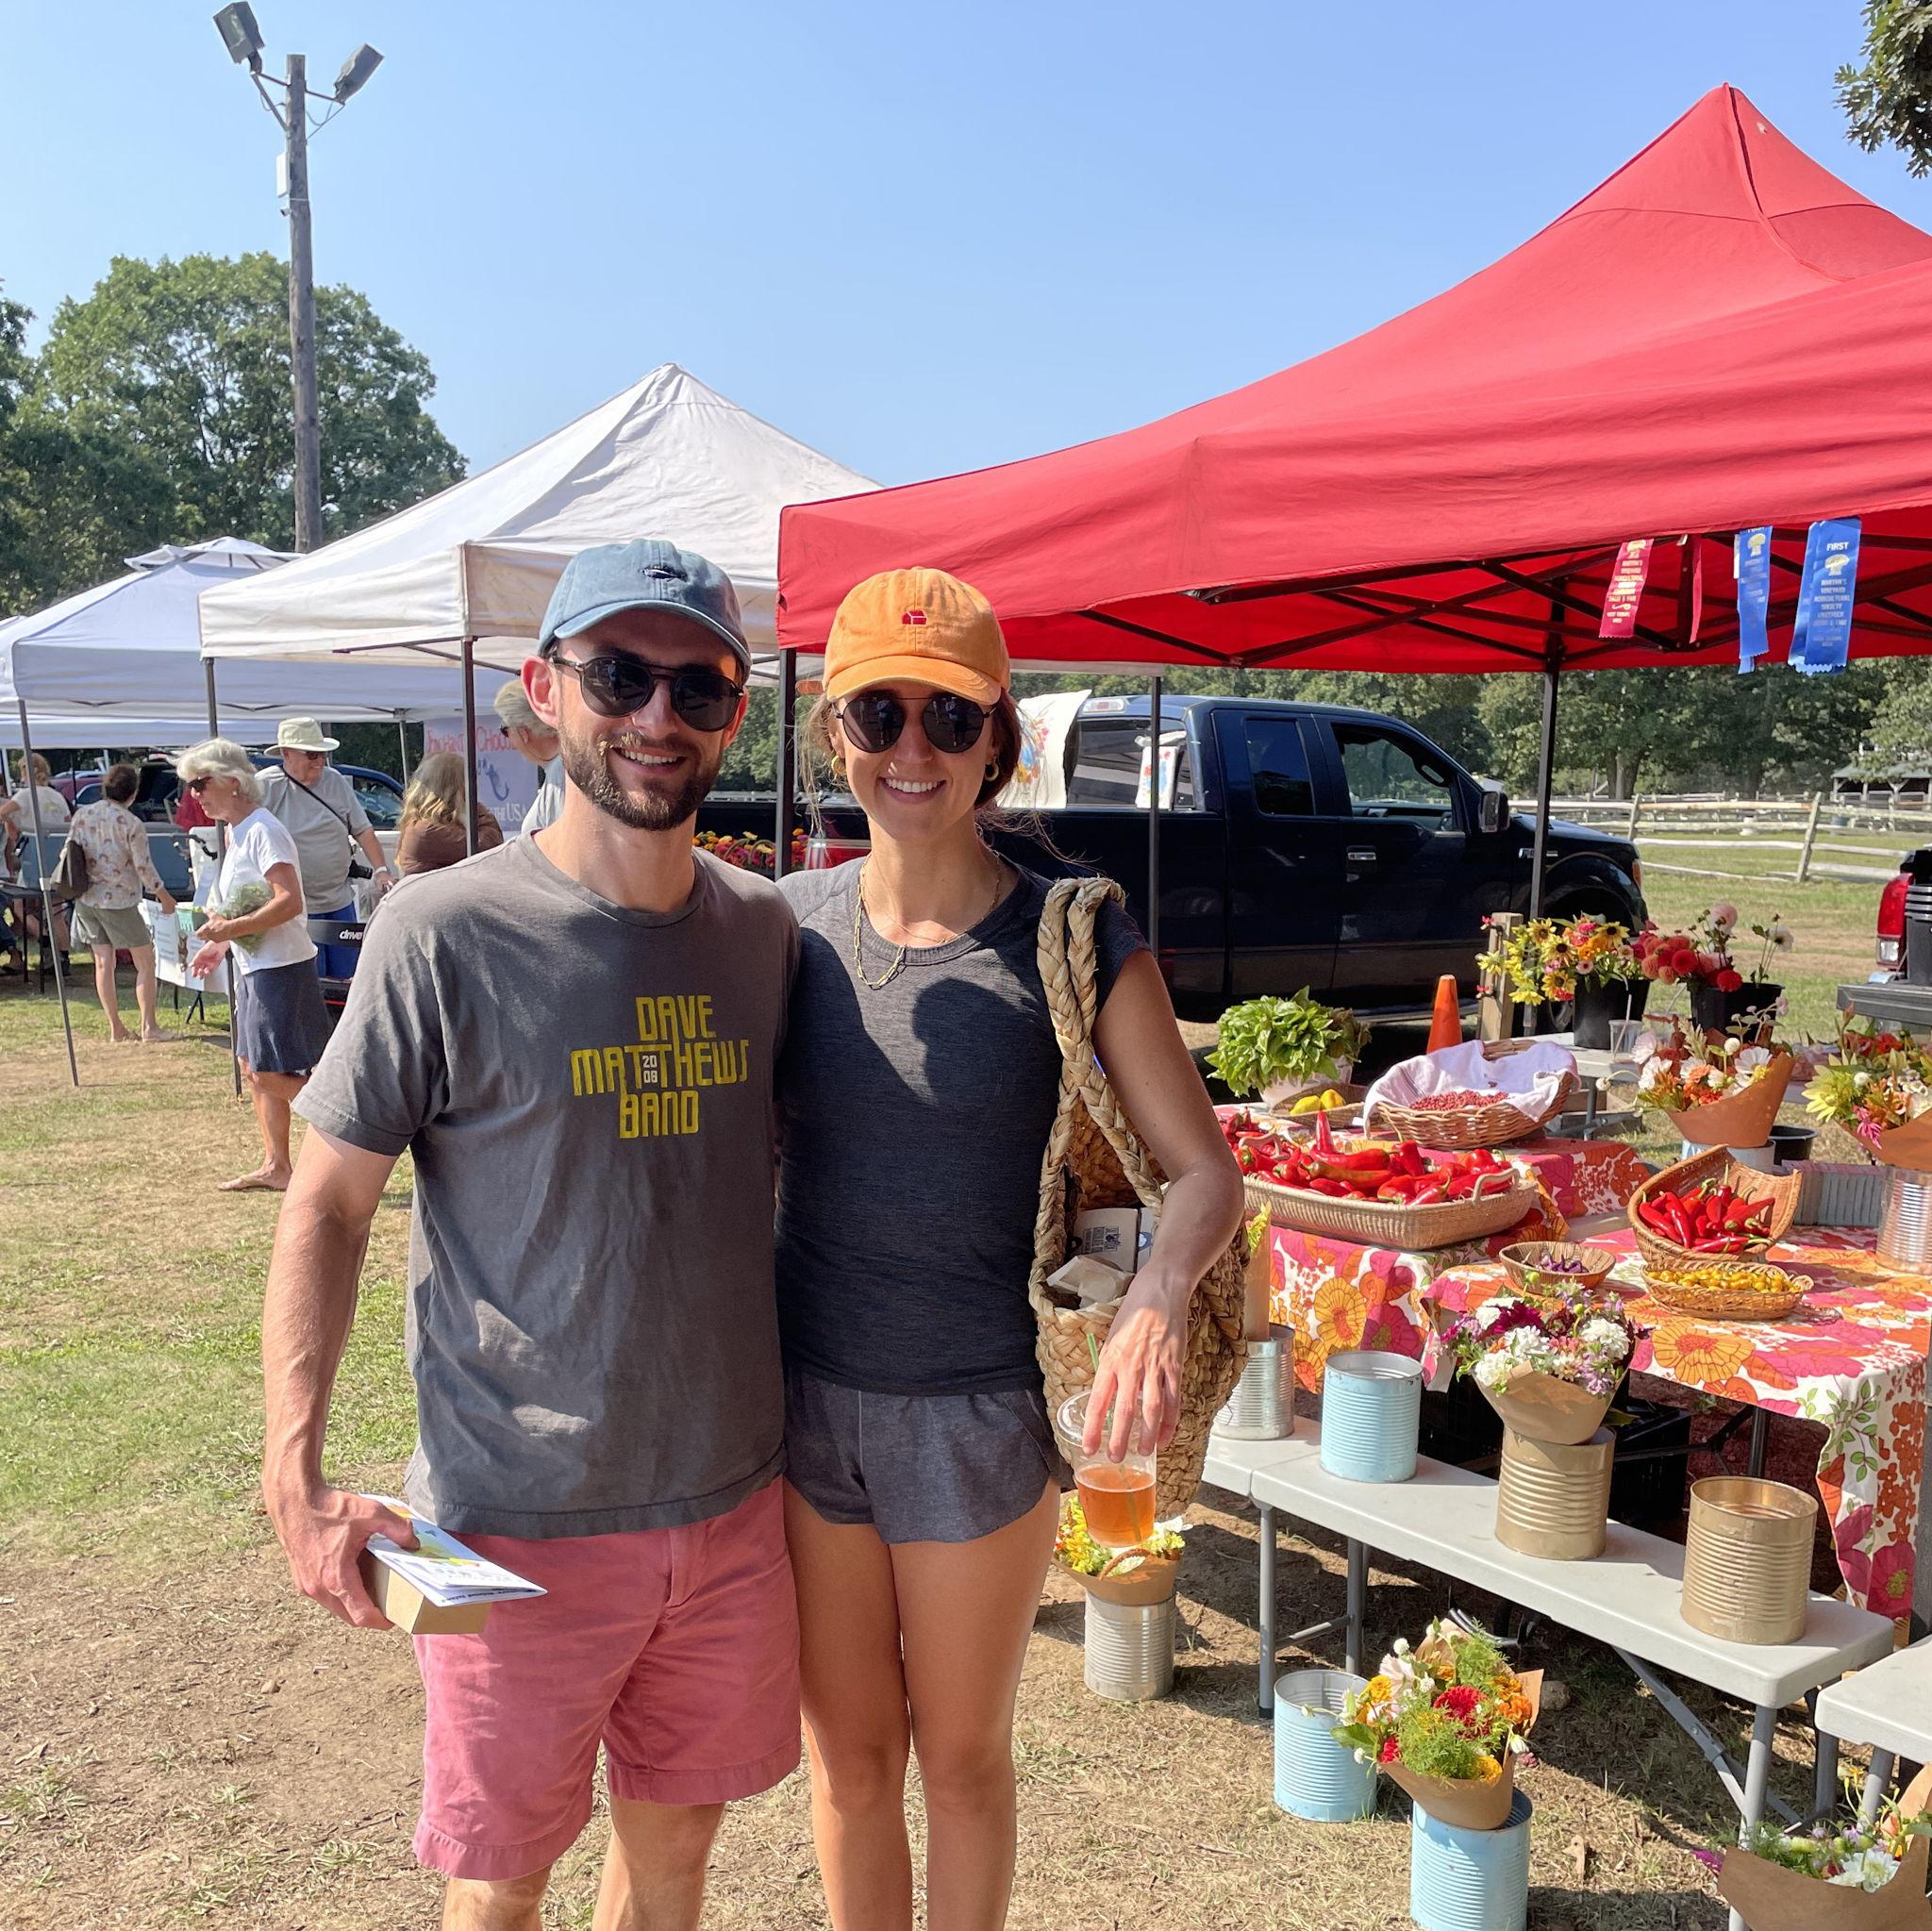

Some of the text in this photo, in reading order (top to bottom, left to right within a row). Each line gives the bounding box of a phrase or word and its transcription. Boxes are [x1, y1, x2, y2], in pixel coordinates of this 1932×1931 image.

[1826, 541, 1849, 551] FIRST
[635, 995, 717, 1041] DAVE
[570, 1040, 749, 1097] MATTHEWS
[619, 1090, 699, 1139] BAND
